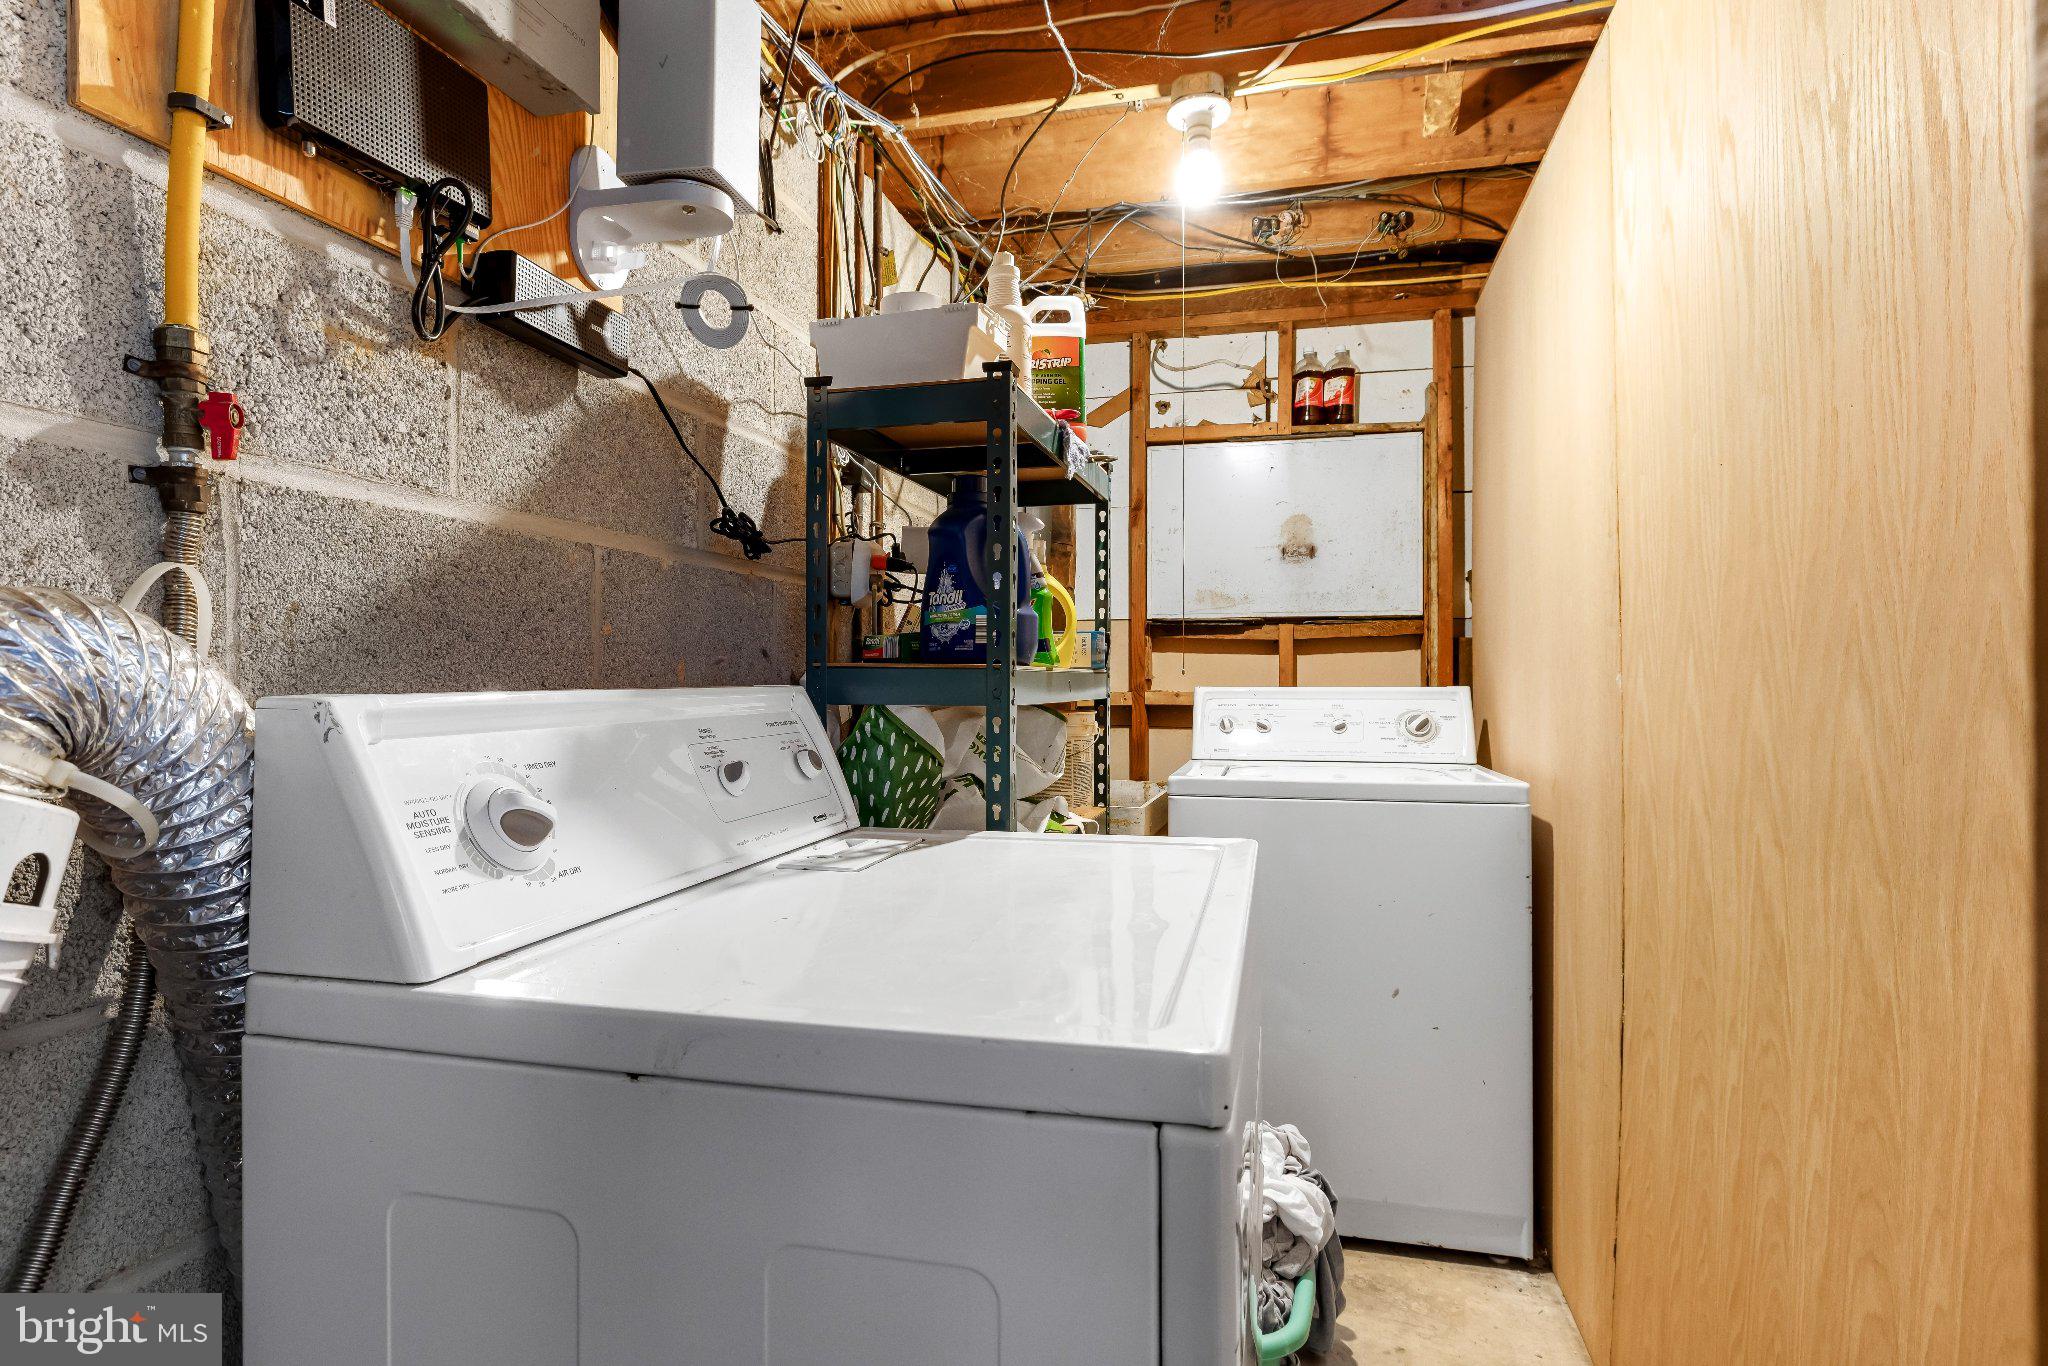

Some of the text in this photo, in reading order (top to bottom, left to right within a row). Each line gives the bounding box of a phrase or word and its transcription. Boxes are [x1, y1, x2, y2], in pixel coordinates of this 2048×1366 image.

[929, 589, 963, 606] Tandil
[413, 808, 437, 820] AUTO
[405, 815, 451, 831] MOISTURE
[413, 825, 452, 839] SENSING
[558, 865, 582, 878] AIR DRY
